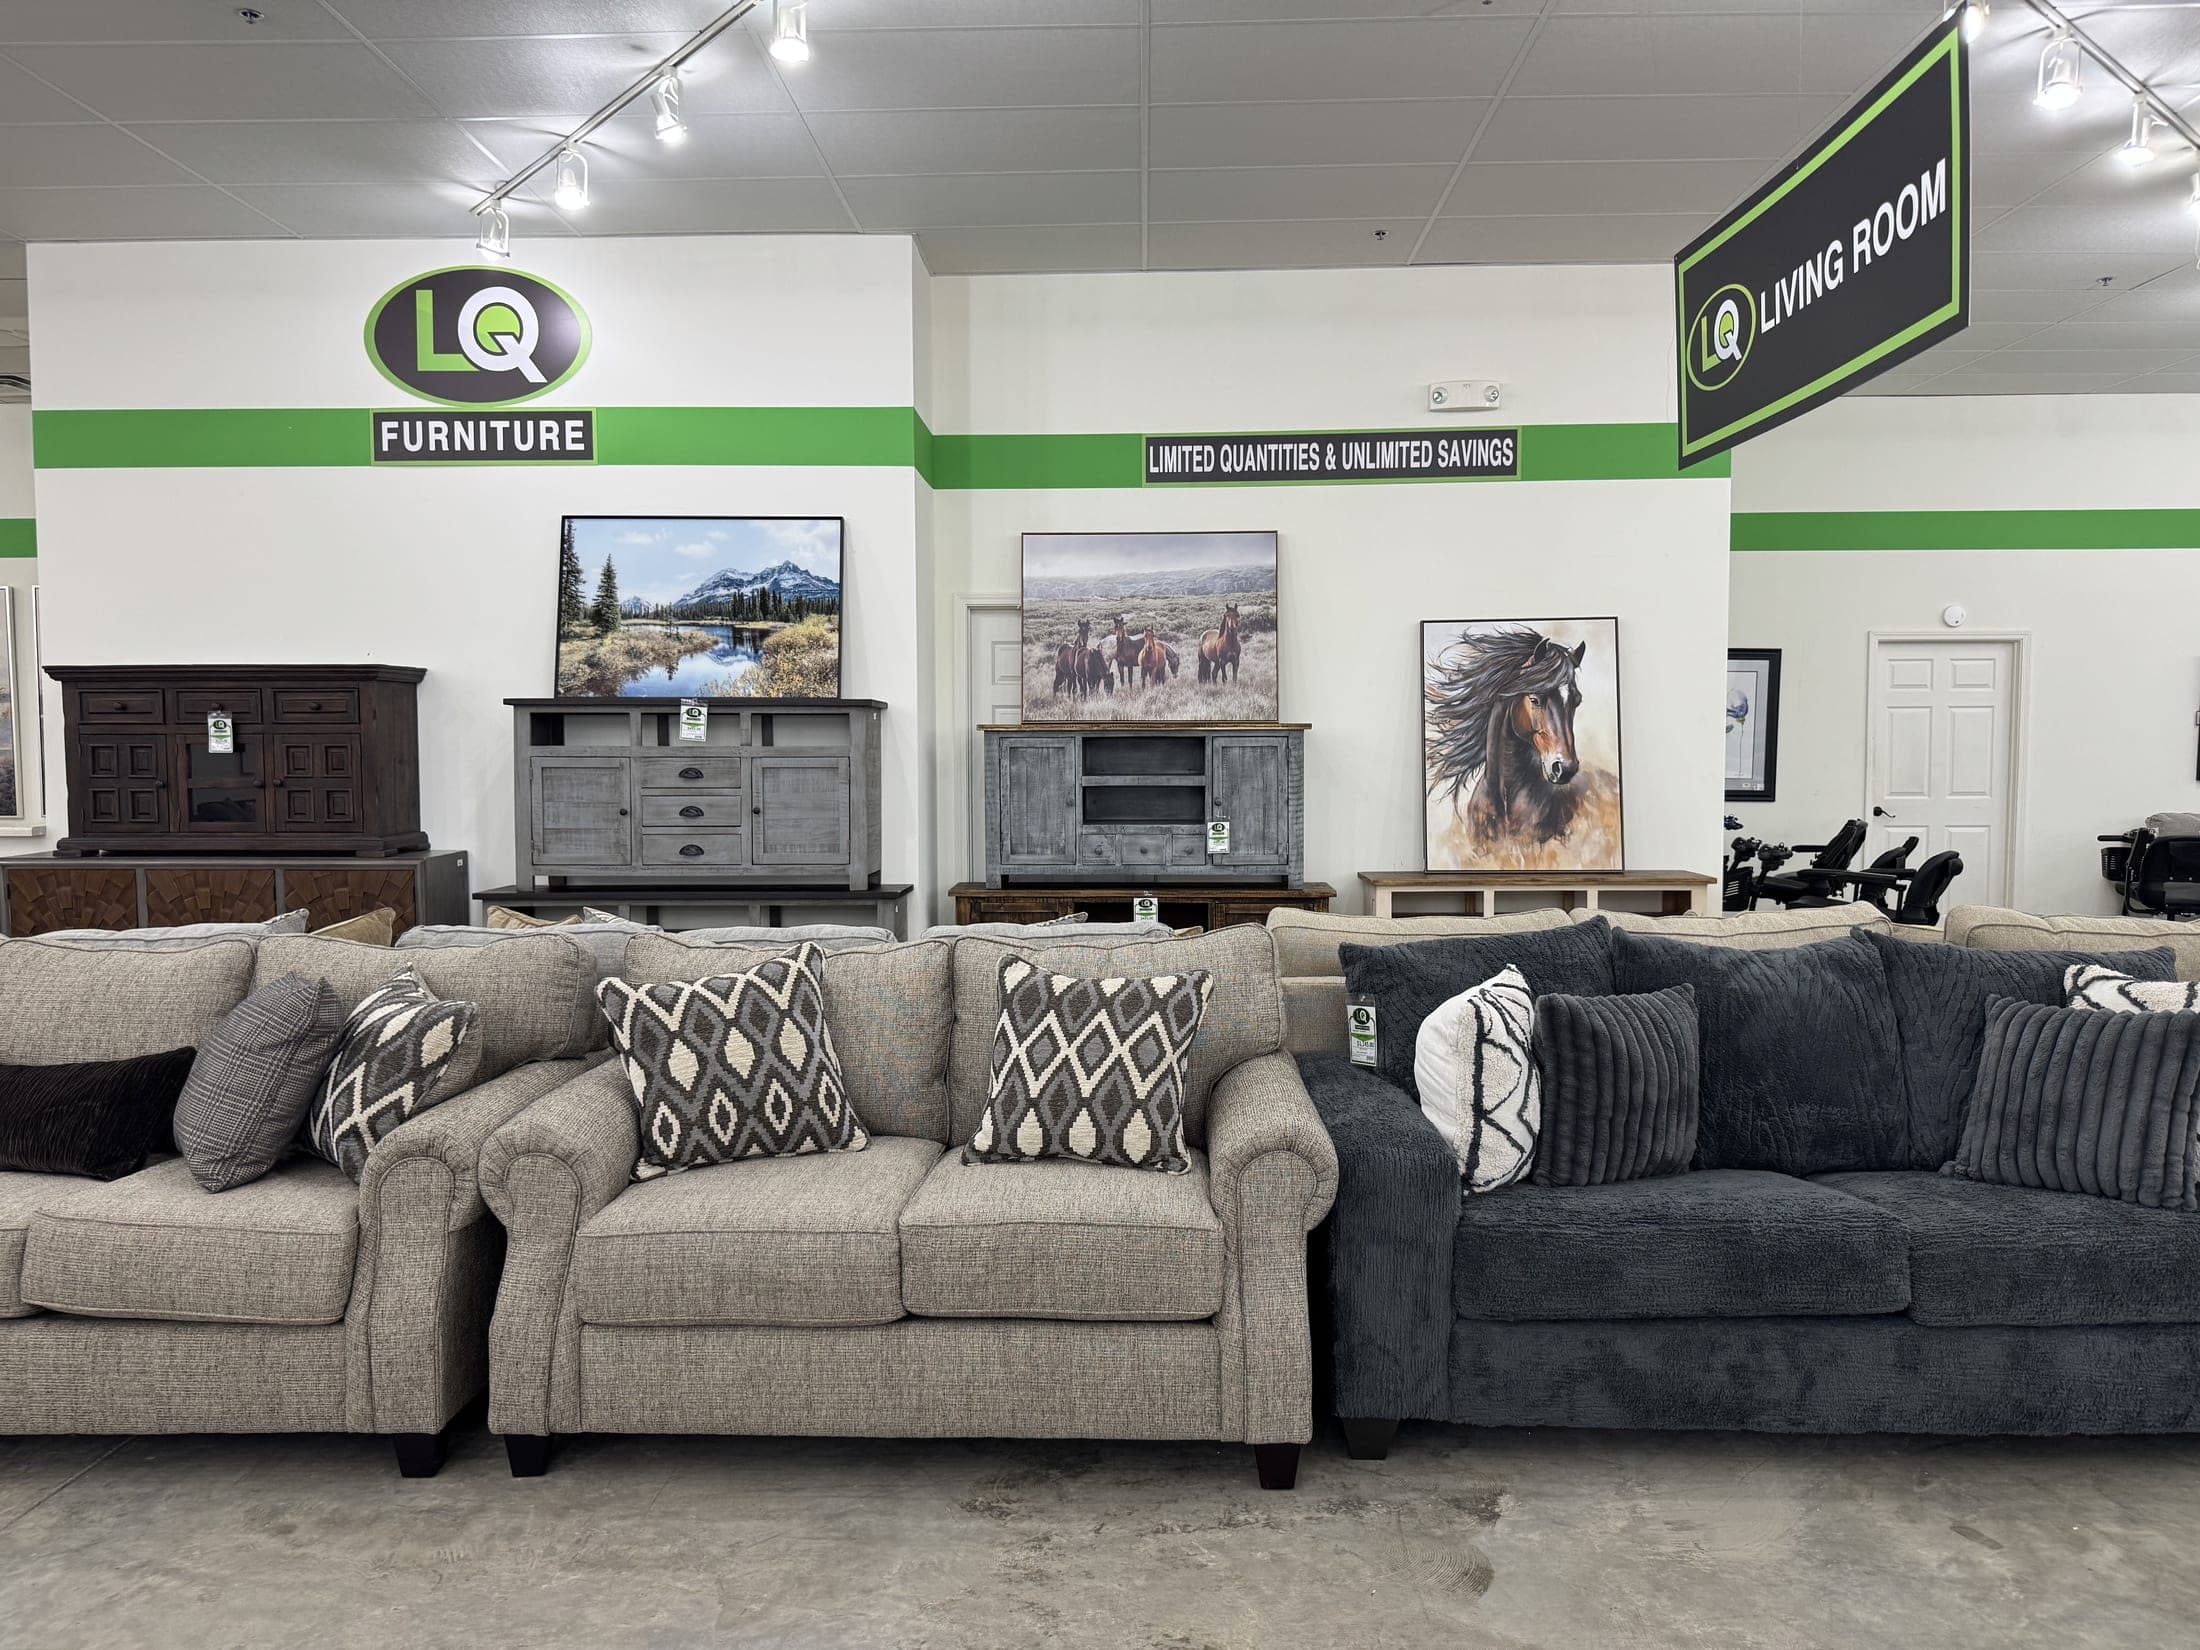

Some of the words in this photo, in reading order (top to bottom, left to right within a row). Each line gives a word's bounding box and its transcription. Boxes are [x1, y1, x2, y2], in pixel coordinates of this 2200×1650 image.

[1701, 298, 1742, 373] LQ
[1760, 239, 1844, 334] LIVING
[1852, 157, 1946, 274] ROOM
[415, 286, 549, 383] LQ
[381, 419, 585, 452] FURNITURE
[1149, 444, 1215, 474] LIMITED
[1219, 441, 1320, 474] QUANTITIES
[1324, 442, 1337, 471] &
[1342, 439, 1433, 471] UNLIMITED
[1437, 436, 1514, 468] SAVINGS
